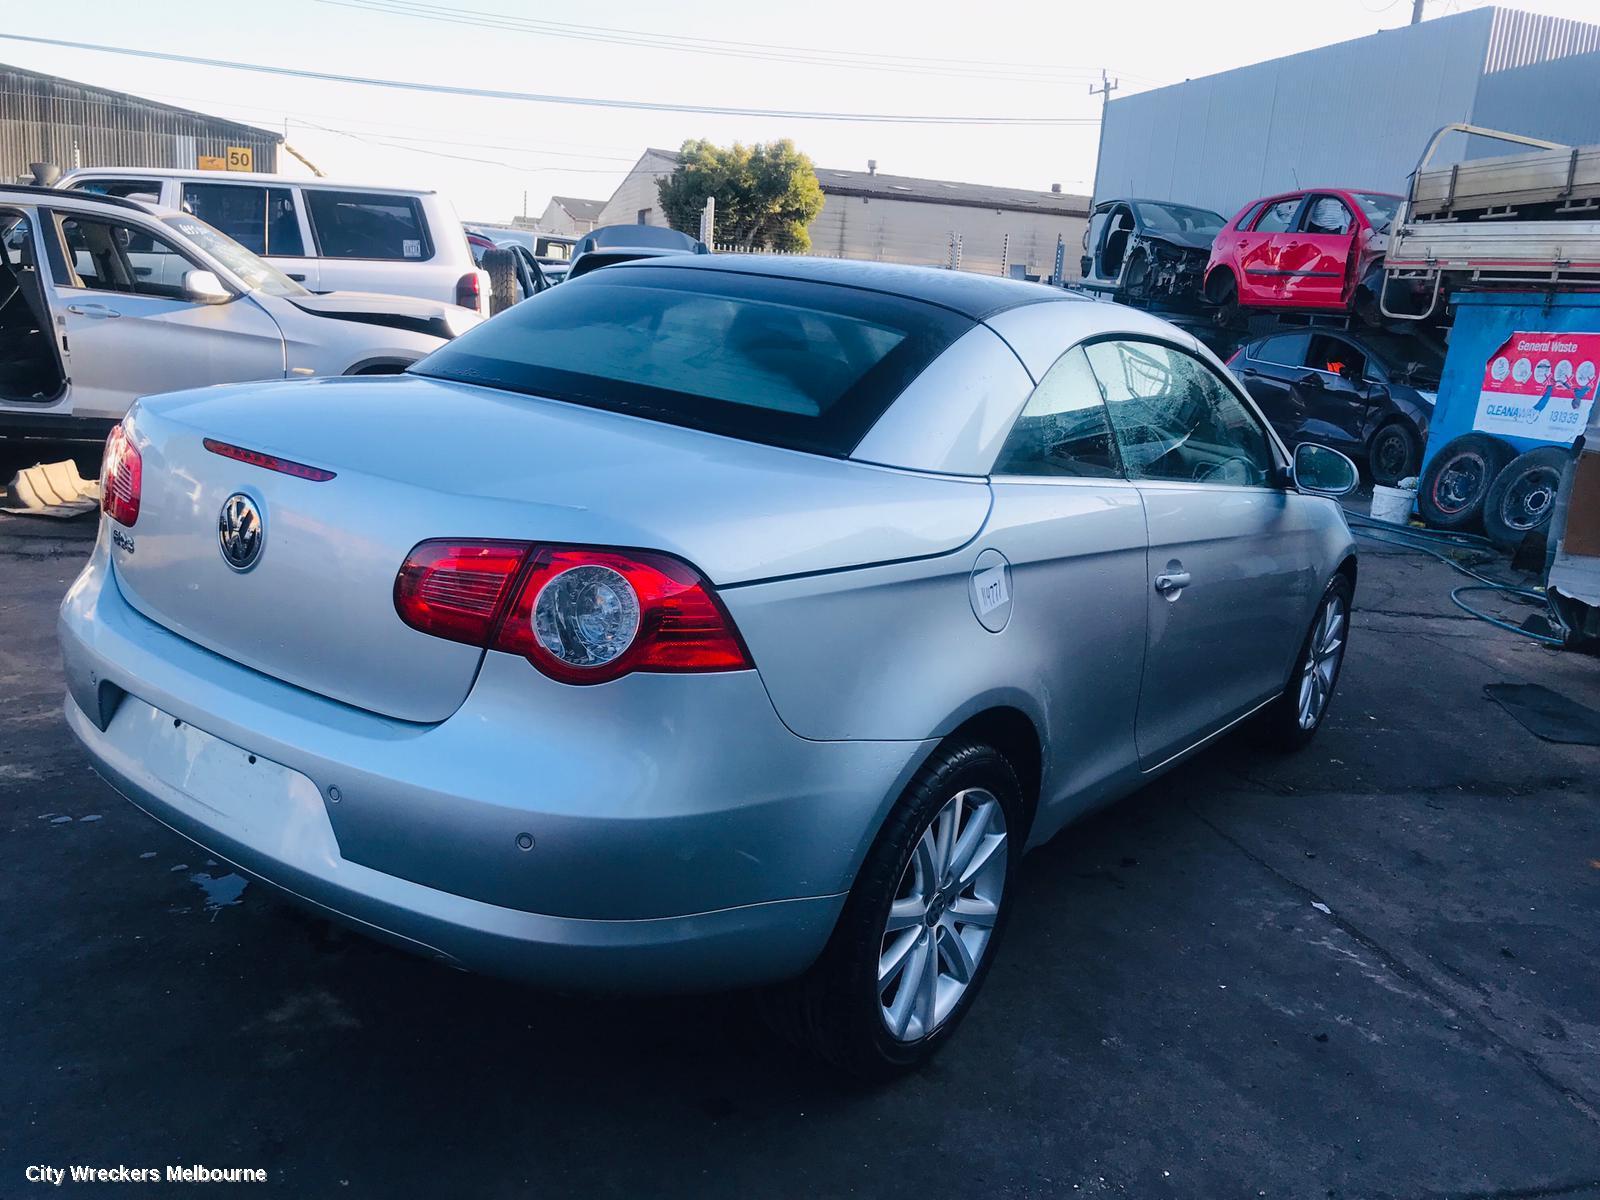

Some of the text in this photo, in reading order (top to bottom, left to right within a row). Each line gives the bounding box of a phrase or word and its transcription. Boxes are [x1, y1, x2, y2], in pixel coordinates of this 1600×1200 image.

[230, 152, 250, 167] 50
[1518, 340, 1577, 352] General Waste
